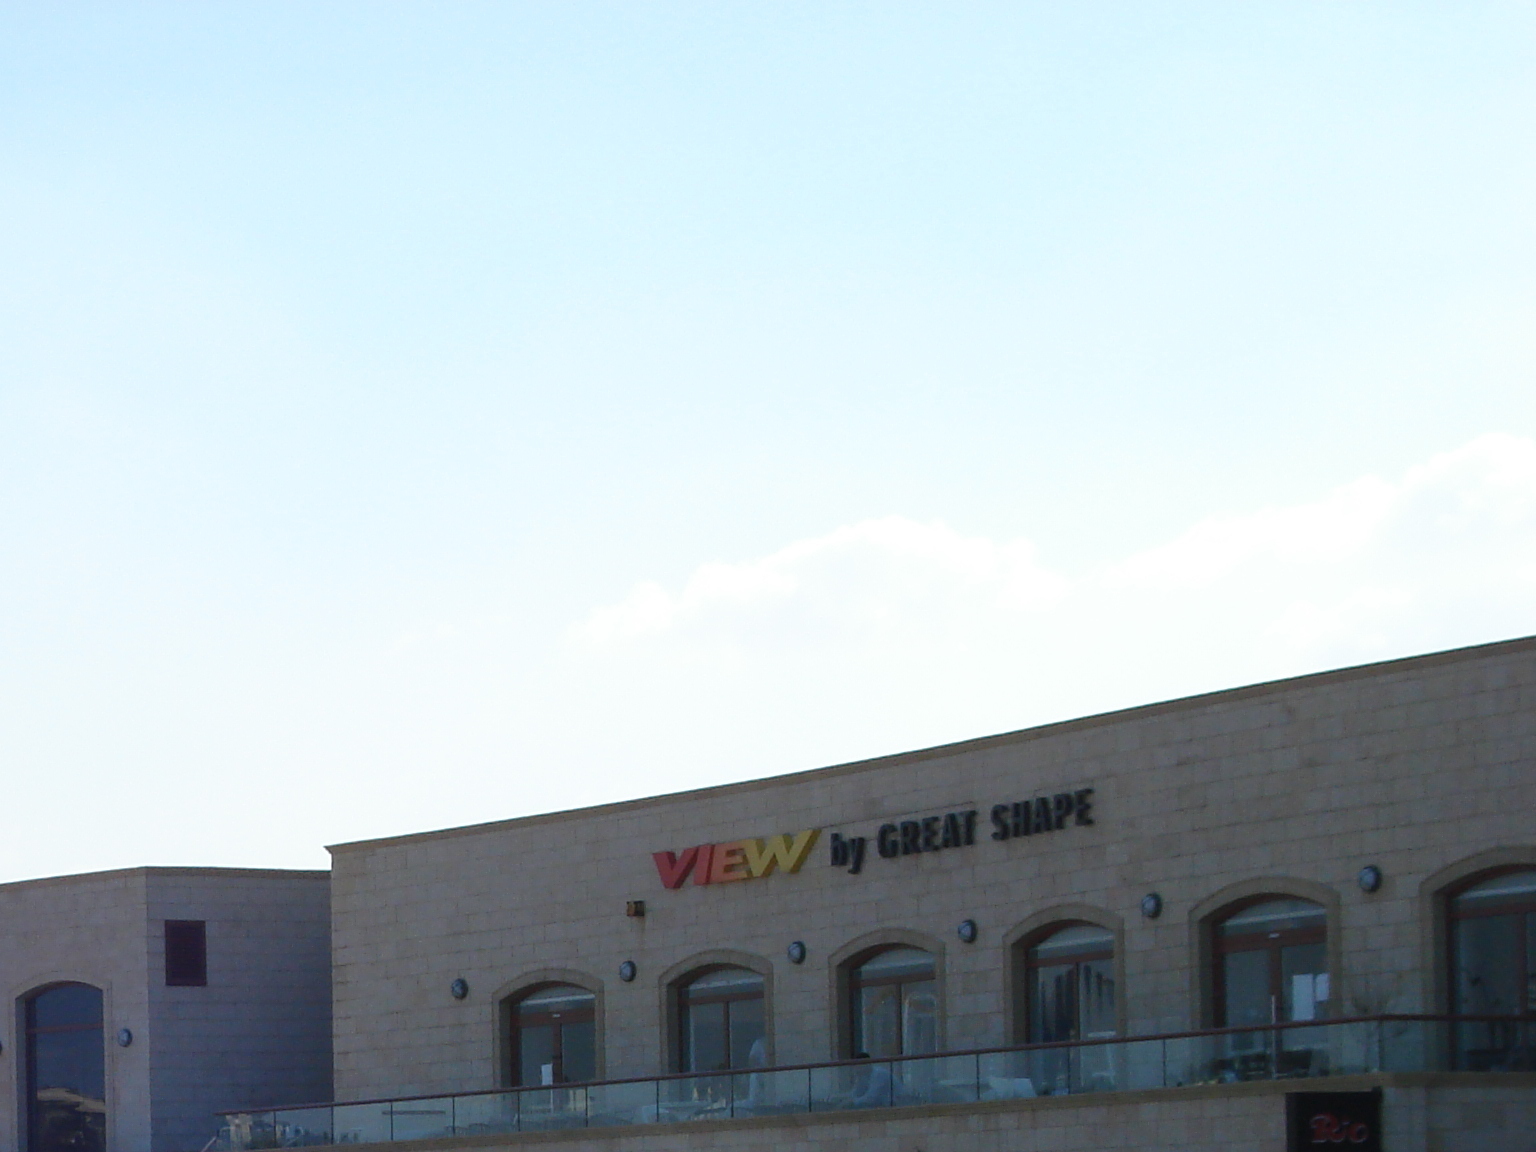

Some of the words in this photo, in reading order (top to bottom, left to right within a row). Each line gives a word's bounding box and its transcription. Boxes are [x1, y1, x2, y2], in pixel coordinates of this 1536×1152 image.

[653, 828, 822, 890] VIEW
[830, 833, 865, 874] by
[877, 811, 978, 858] GREAT
[991, 789, 1094, 840] SHAPE
